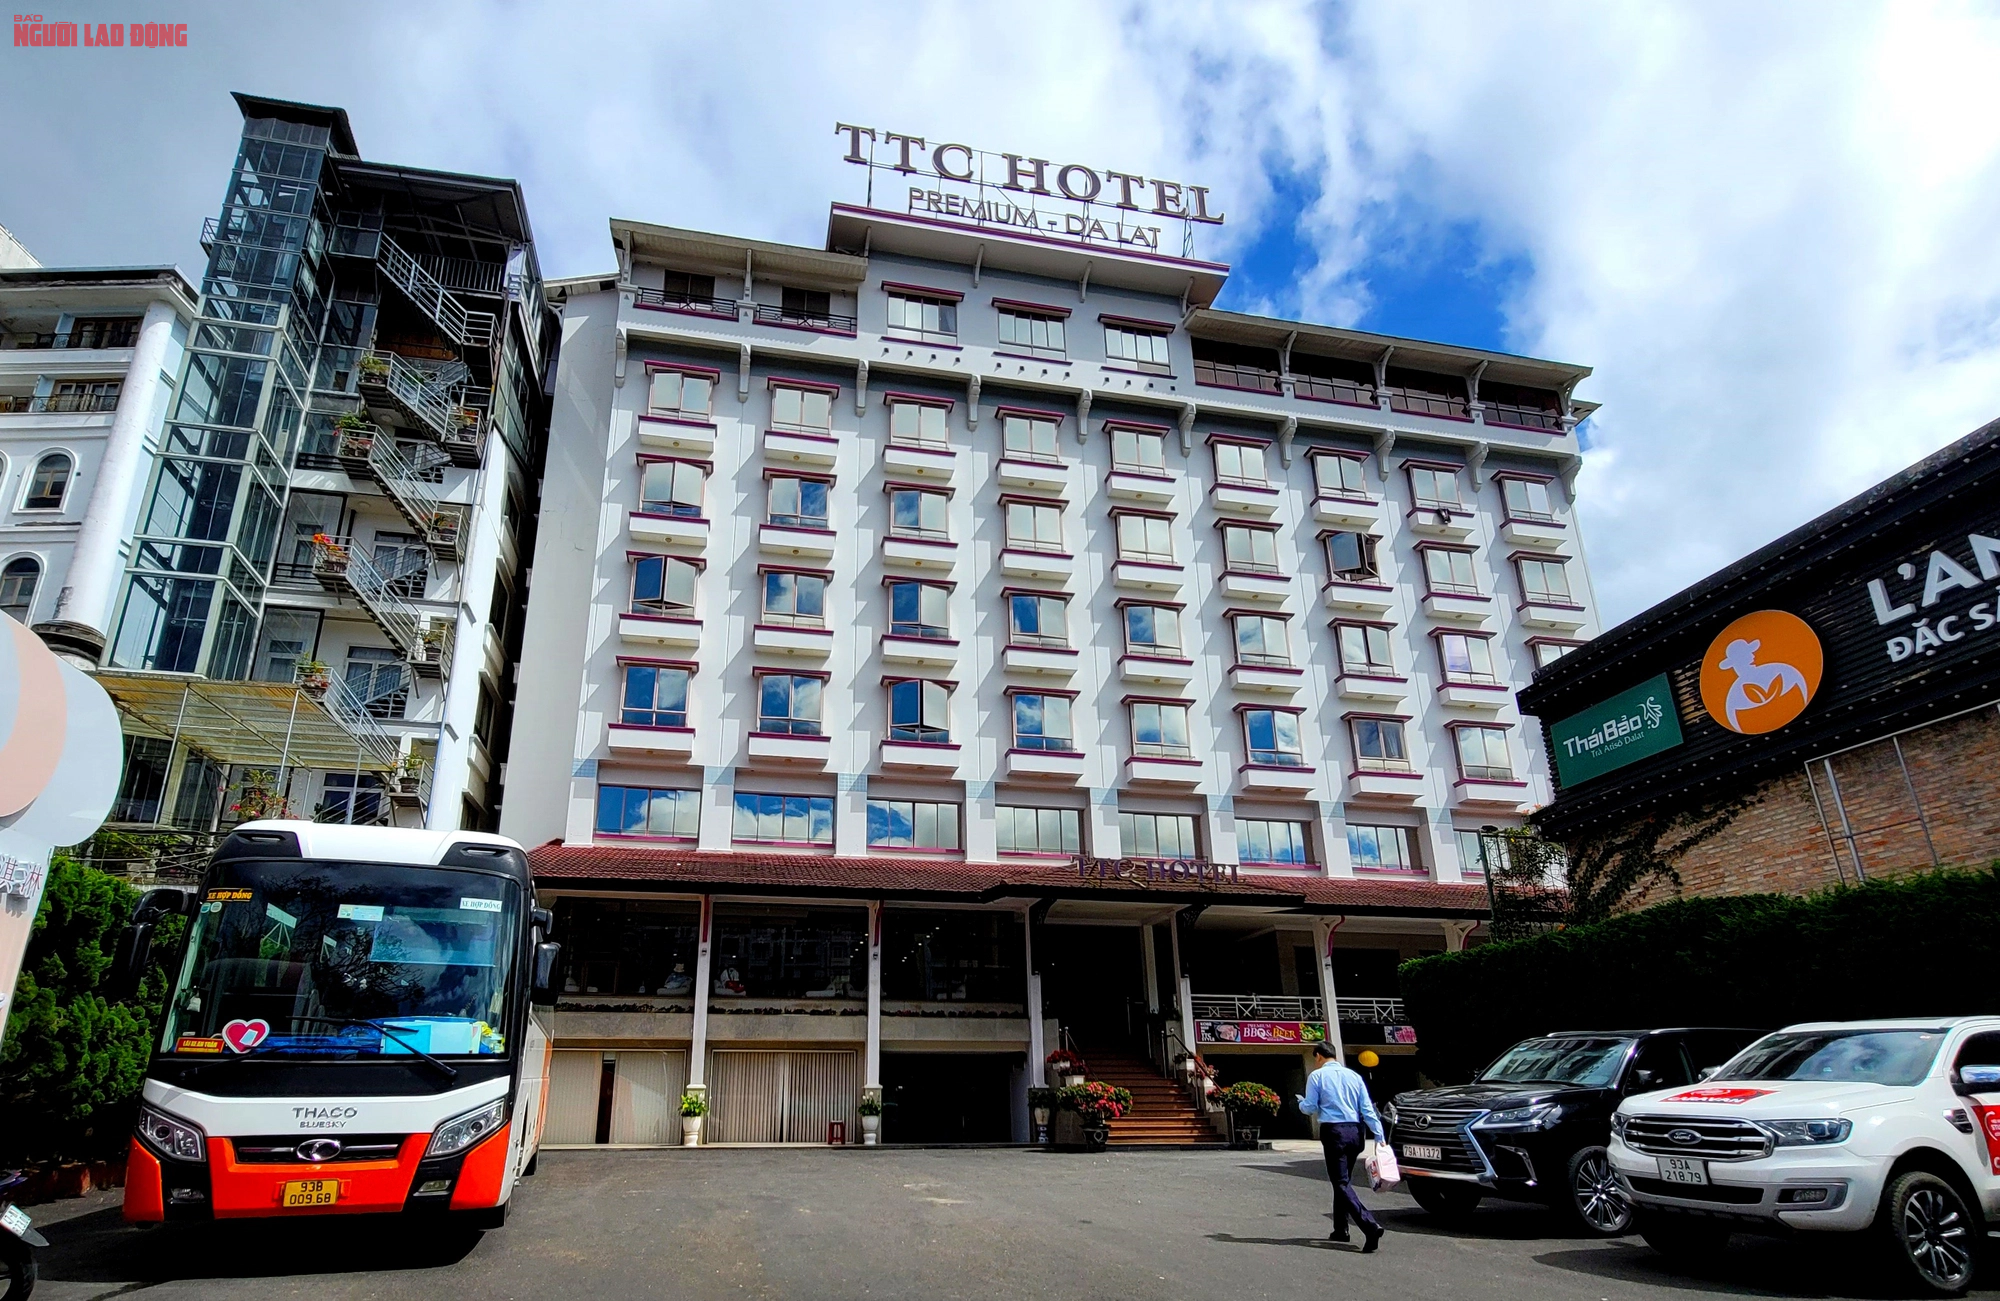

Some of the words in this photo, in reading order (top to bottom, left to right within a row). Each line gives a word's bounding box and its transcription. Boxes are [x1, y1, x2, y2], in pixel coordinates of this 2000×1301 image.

[835, 121, 974, 181] TTC
[1001, 153, 1225, 225] HOTEL
[909, 187, 1039, 229] PREMIUM
[1886, 617, 1965, 663] ĐẶC
[1969, 586, 2000, 631] S
[1624, 731, 1645, 745] Dalat
[1070, 855, 1136, 880] TTC
[1144, 859, 1246, 885] HOTEL
[292, 1107, 358, 1119] THACO
[299, 1121, 347, 1129] BLUESKY
[1669, 1158, 1691, 1170] 93A
[1665, 1169, 1703, 1183] 218.79
[301, 1181, 324, 1193] 93B
[289, 1193, 332, 1205] 009.68
